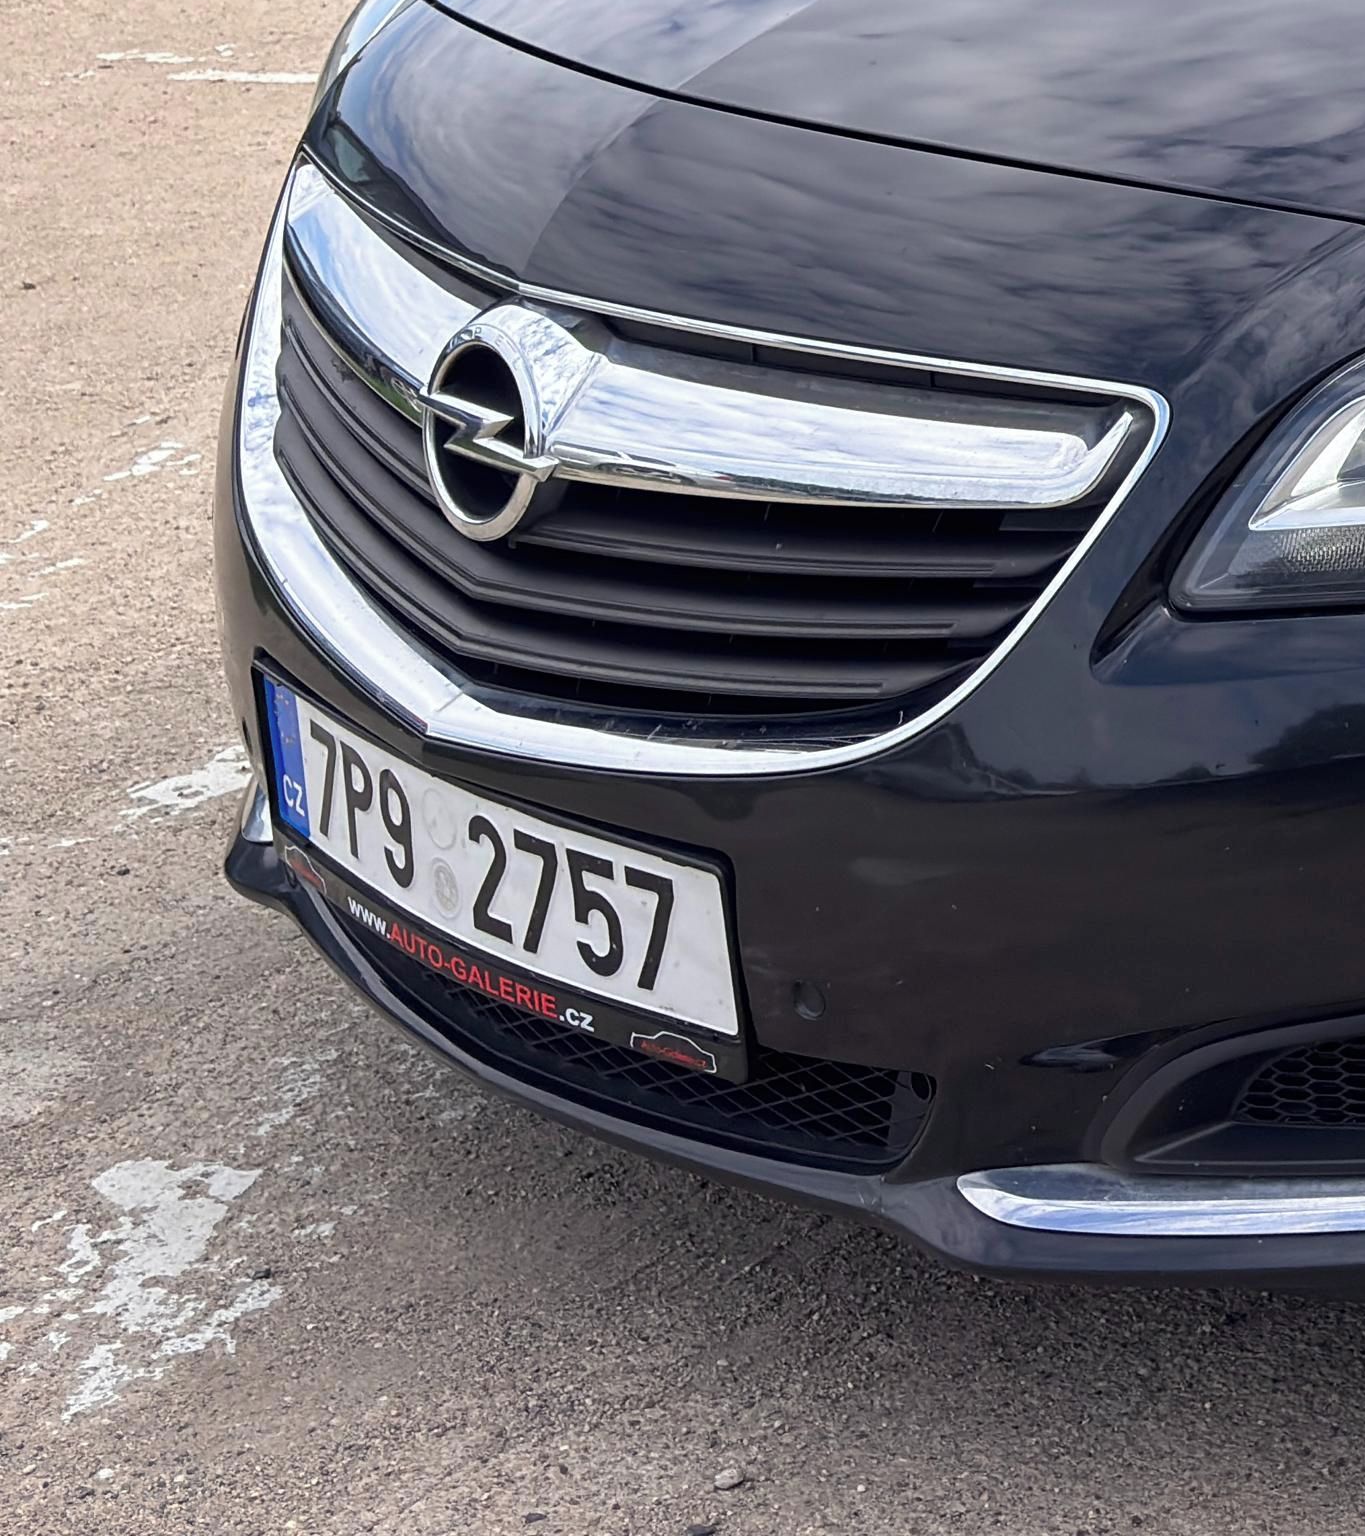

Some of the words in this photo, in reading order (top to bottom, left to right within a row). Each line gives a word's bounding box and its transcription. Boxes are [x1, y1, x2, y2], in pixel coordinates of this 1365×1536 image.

[283, 774, 305, 817] CZ
[310, 718, 415, 889] 7P9
[468, 814, 675, 991] 2757
